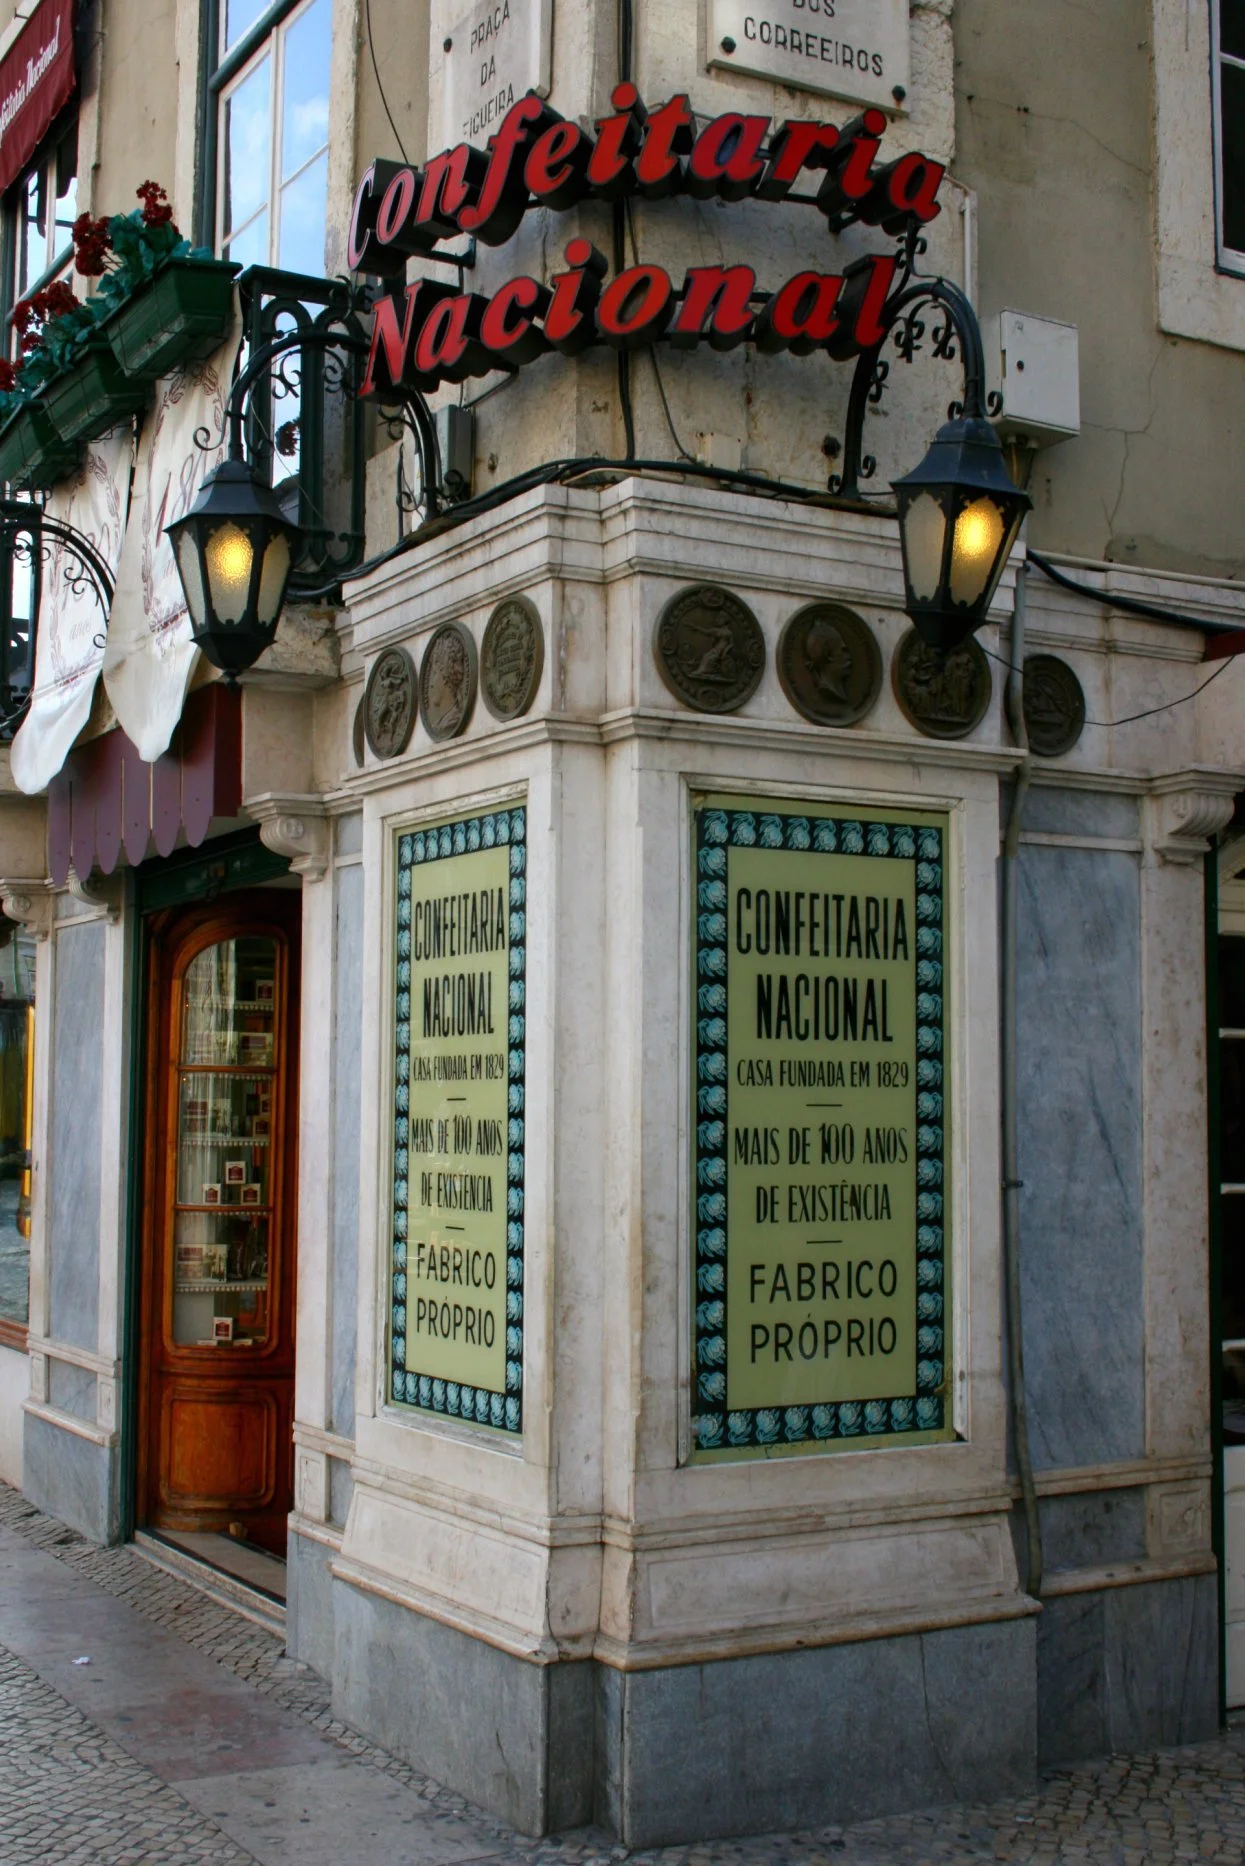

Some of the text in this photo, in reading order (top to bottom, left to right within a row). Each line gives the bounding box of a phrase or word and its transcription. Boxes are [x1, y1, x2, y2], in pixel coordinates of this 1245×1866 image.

[470, 0, 510, 54] PRAÇA
[744, 16, 883, 77] CORREEIROS
[26, 14, 61, 97] Nacional
[480, 55, 496, 87] DA
[462, 83, 514, 139] FIGUEIRA
[348, 81, 945, 271] Confeitaria
[358, 236, 897, 397] Nacional
[414, 887, 506, 962] CONFEITARIA
[736, 887, 909, 961] CONFEITARIA
[423, 971, 495, 1038] NACIONAL
[756, 973, 893, 1042] NACIONAL
[413, 1053, 505, 1082] CASA FUNDADA EM 1829
[736, 1059, 909, 1088] CASA FUNDADA EM 1829
[411, 1114, 503, 1157] MAIS DE 100 ANOS
[734, 1122, 909, 1165] MAIS DE 100 ANOS
[421, 1169, 493, 1213] DE EXISTÊNCIA
[756, 1180, 892, 1223] DE EXISTÊNCIA
[416, 1242, 496, 1290] FABRICO
[750, 1259, 898, 1304] FABRICO
[416, 1295, 495, 1348] PRÓPRIO
[750, 1313, 898, 1364] PRÓPRIO
